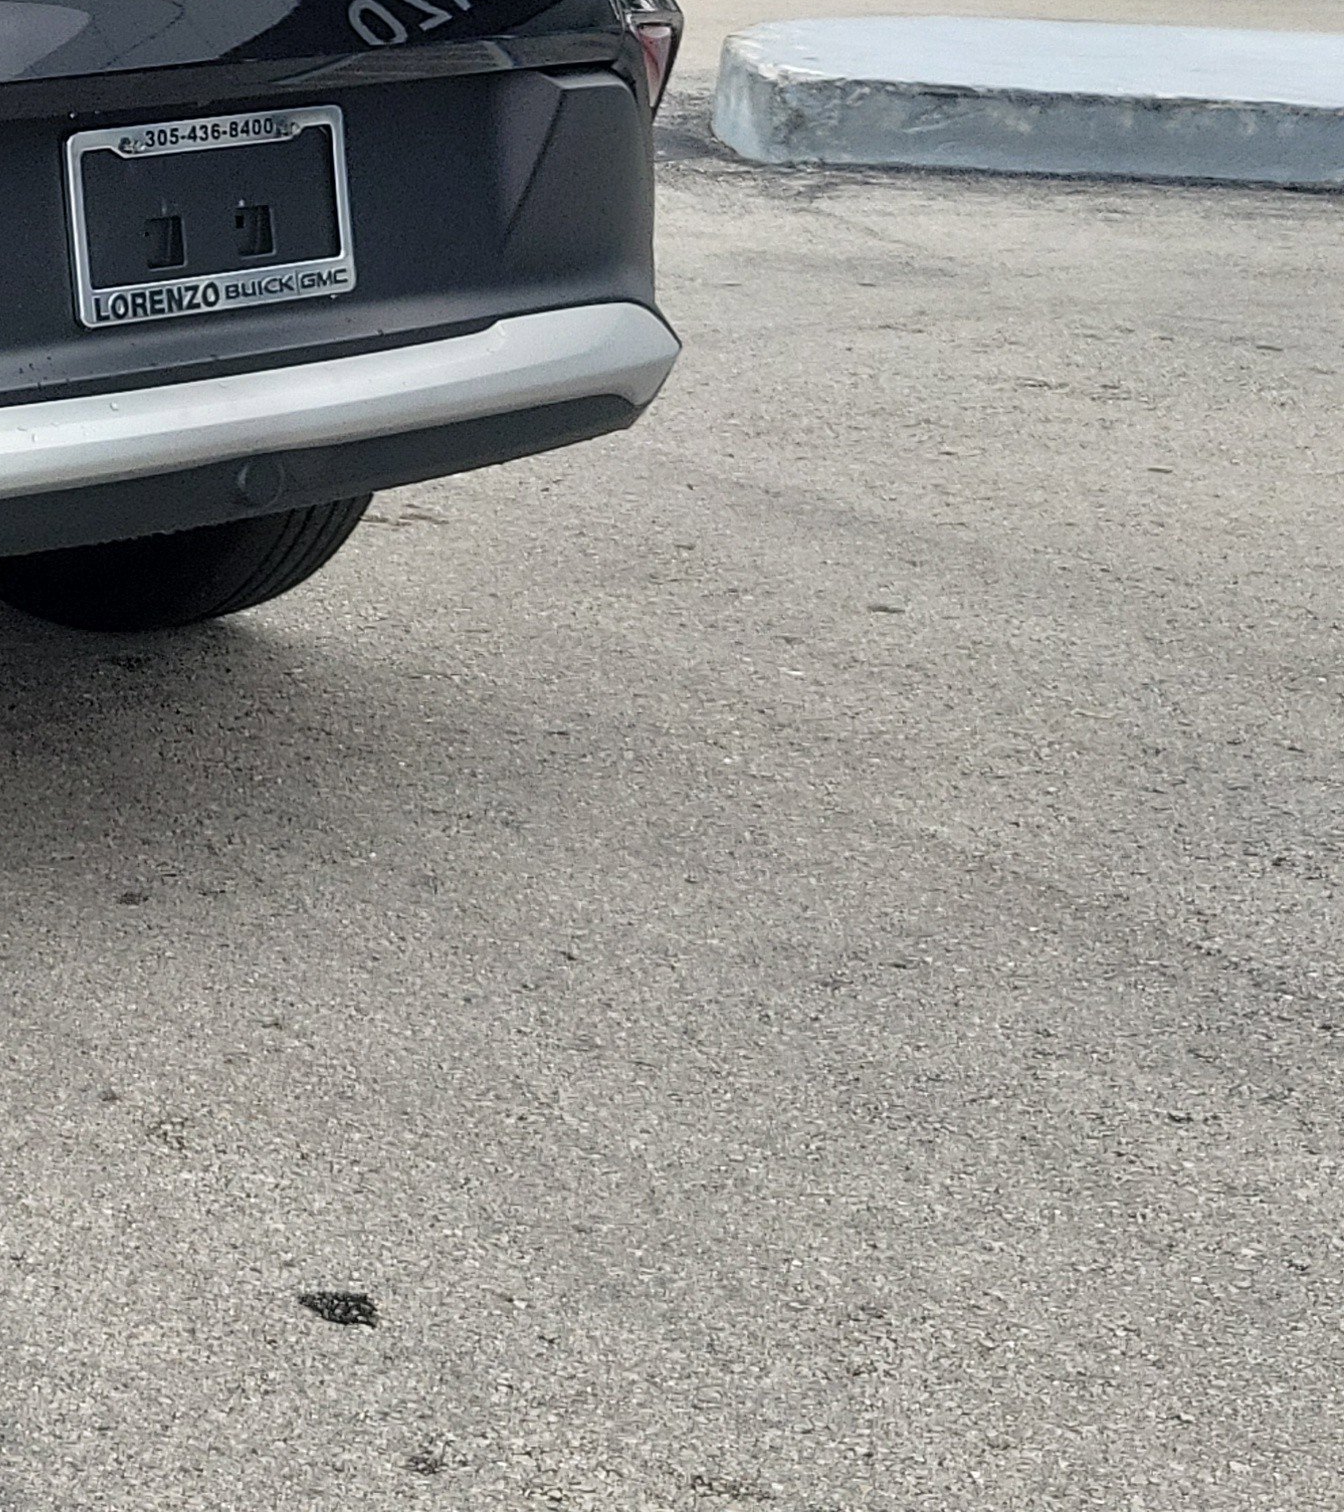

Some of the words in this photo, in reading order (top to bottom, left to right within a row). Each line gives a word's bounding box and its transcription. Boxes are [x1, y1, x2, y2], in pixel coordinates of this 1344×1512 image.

[145, 117, 274, 148] 305-436-8400
[93, 280, 220, 321] LORENZO
[224, 274, 295, 300] BUICK
[300, 268, 348, 289] GMC
